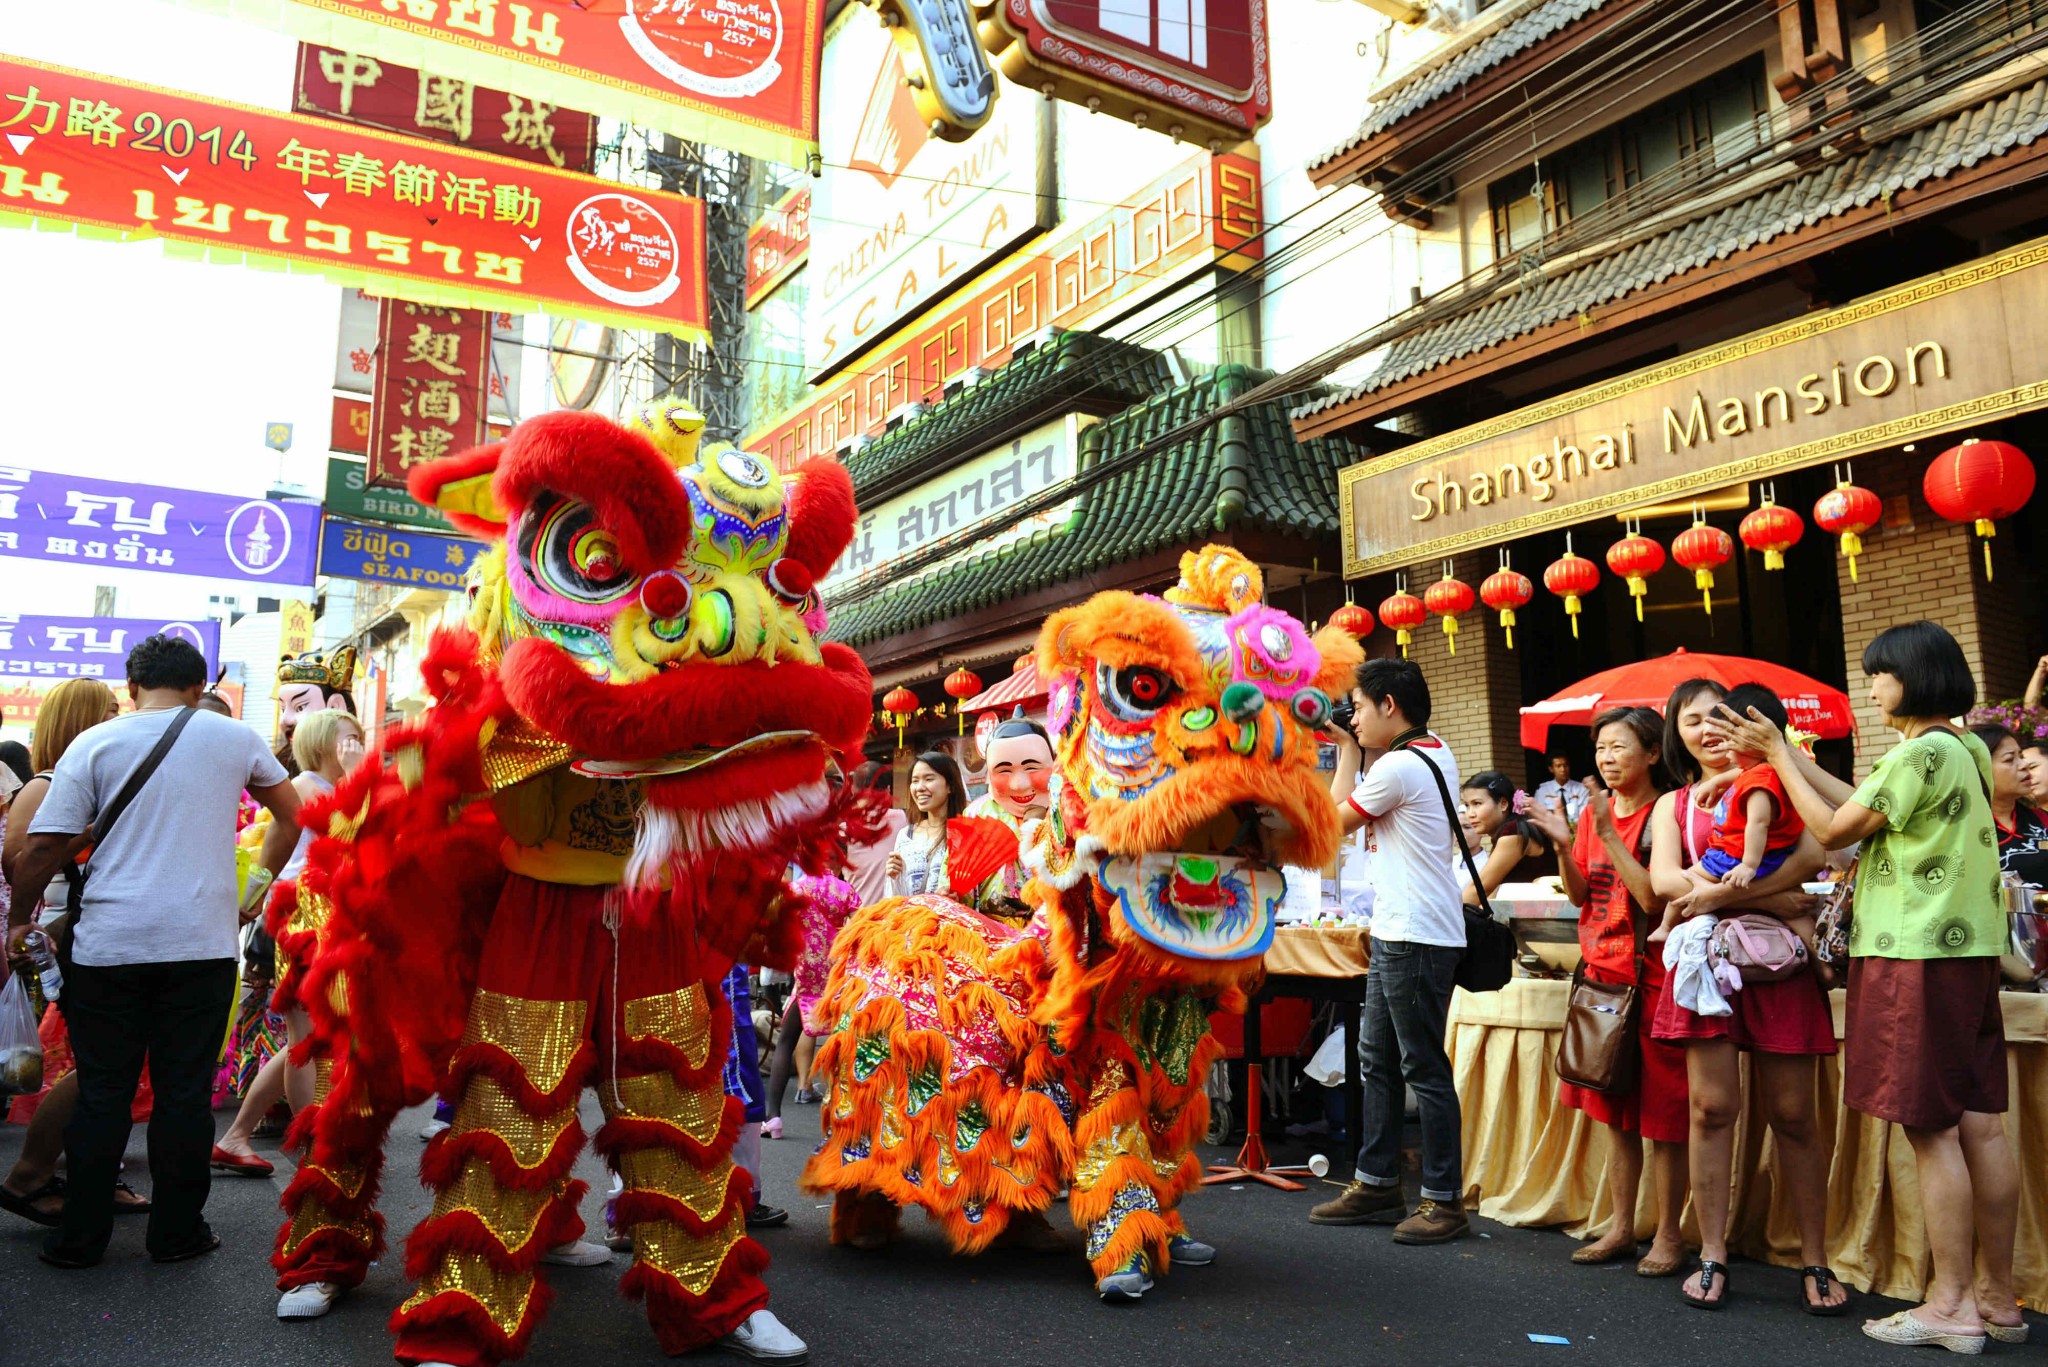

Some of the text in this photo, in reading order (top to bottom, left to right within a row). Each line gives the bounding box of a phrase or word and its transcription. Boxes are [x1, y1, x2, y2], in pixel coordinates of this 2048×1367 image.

[722, 29, 756, 47] 2557
[276, 137, 542, 230] 年春節活動
[824, 210, 907, 299] CHINA
[923, 122, 1009, 219] TOWN
[132, 189, 524, 285] เยาวราช
[637, 256, 660, 268] 2557
[822, 203, 1009, 362] SCALA
[389, 303, 467, 469] 翅酒樓
[1411, 340, 1946, 520] Shanghai Mansion
[363, 497, 419, 518] BIRD
